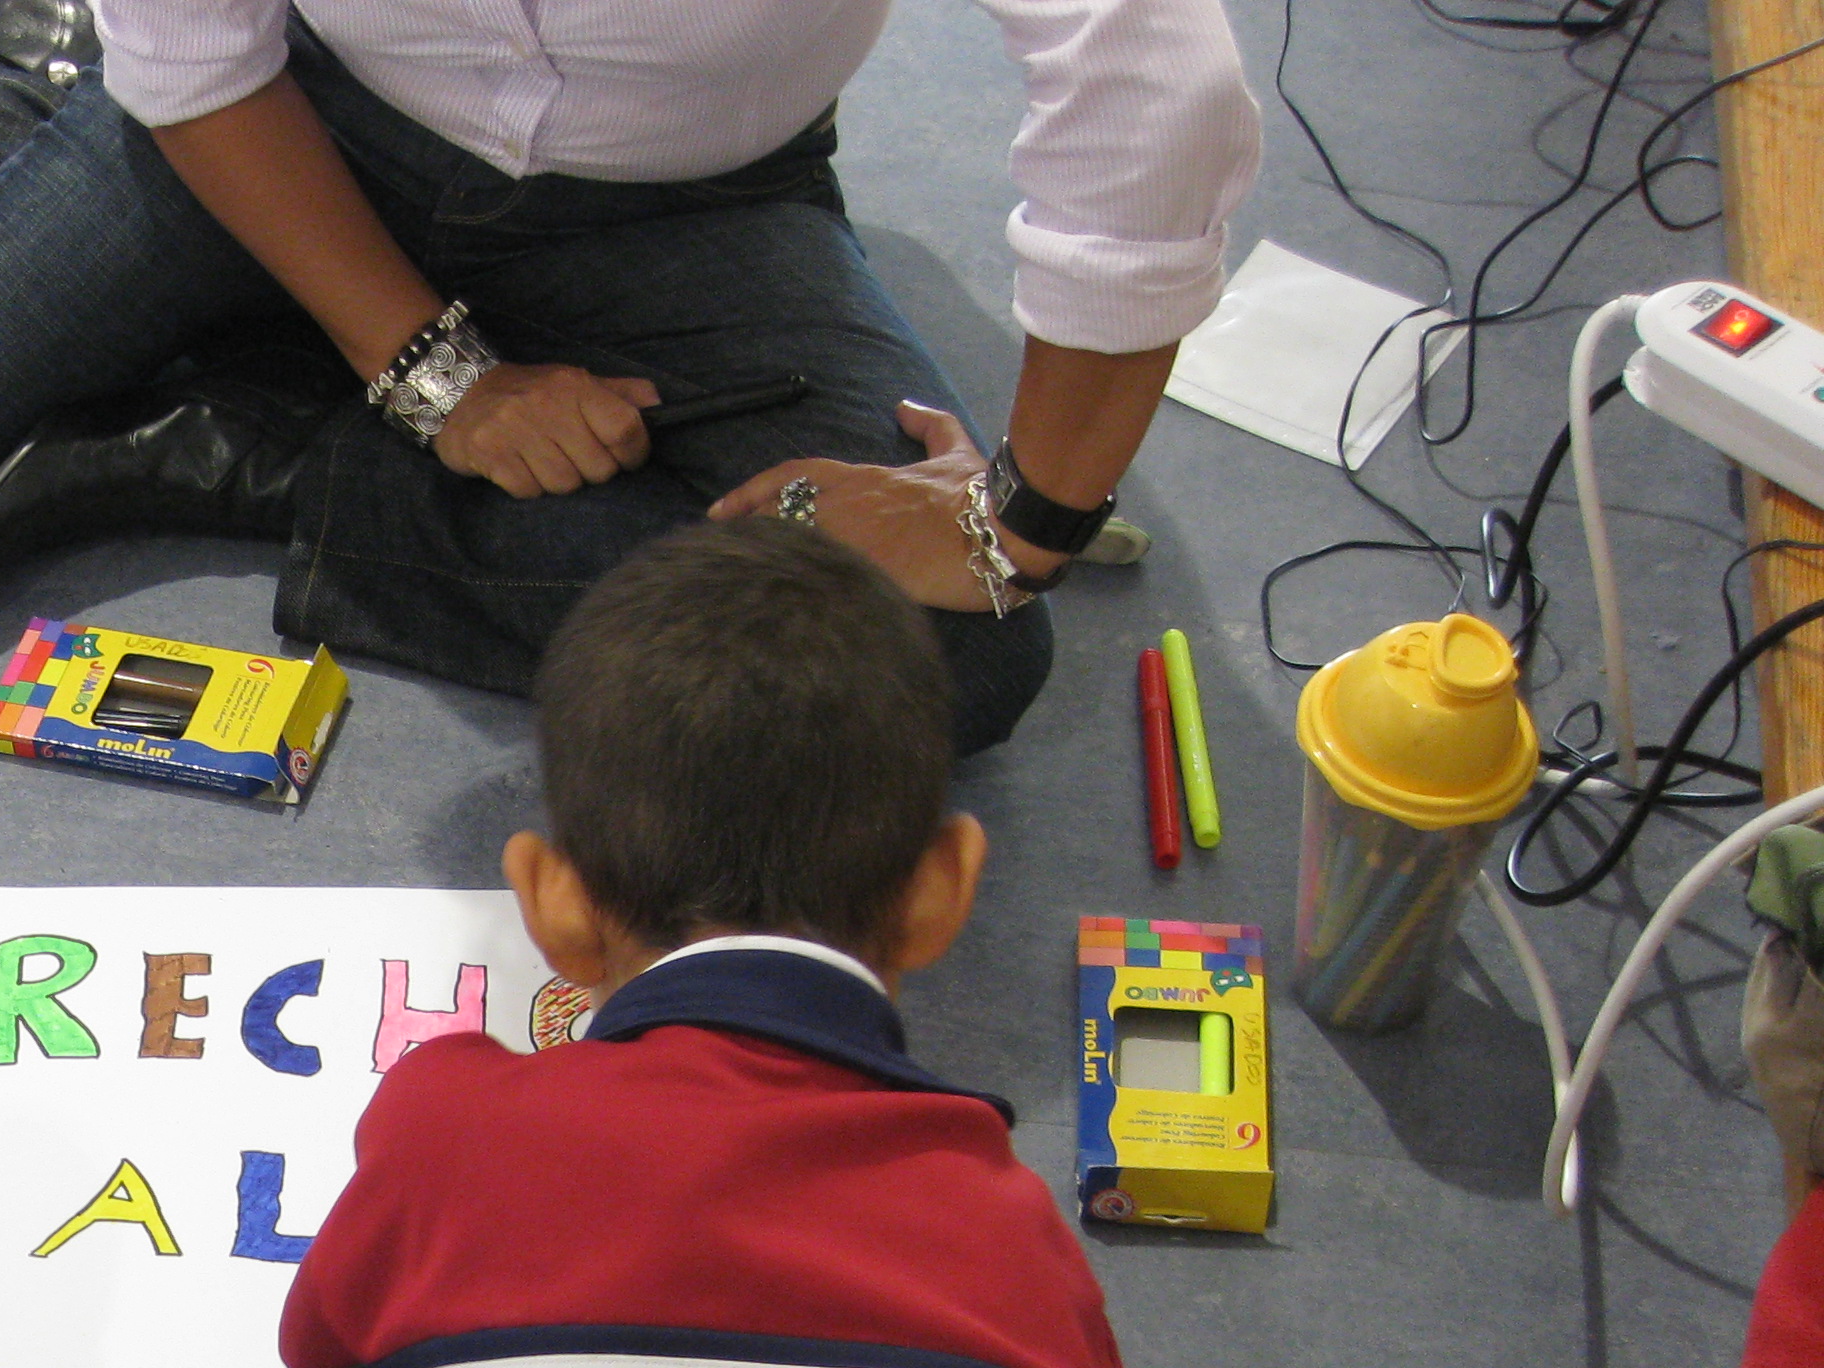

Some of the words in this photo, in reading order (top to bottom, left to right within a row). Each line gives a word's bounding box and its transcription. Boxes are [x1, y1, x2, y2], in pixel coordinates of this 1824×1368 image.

[247, 658, 275, 679] 6
[71, 660, 106, 714] JUMBO
[1125, 985, 1212, 1003] JUMBO
[1233, 1121, 1262, 1151] 6
[29, 1150, 318, 1264] AL
